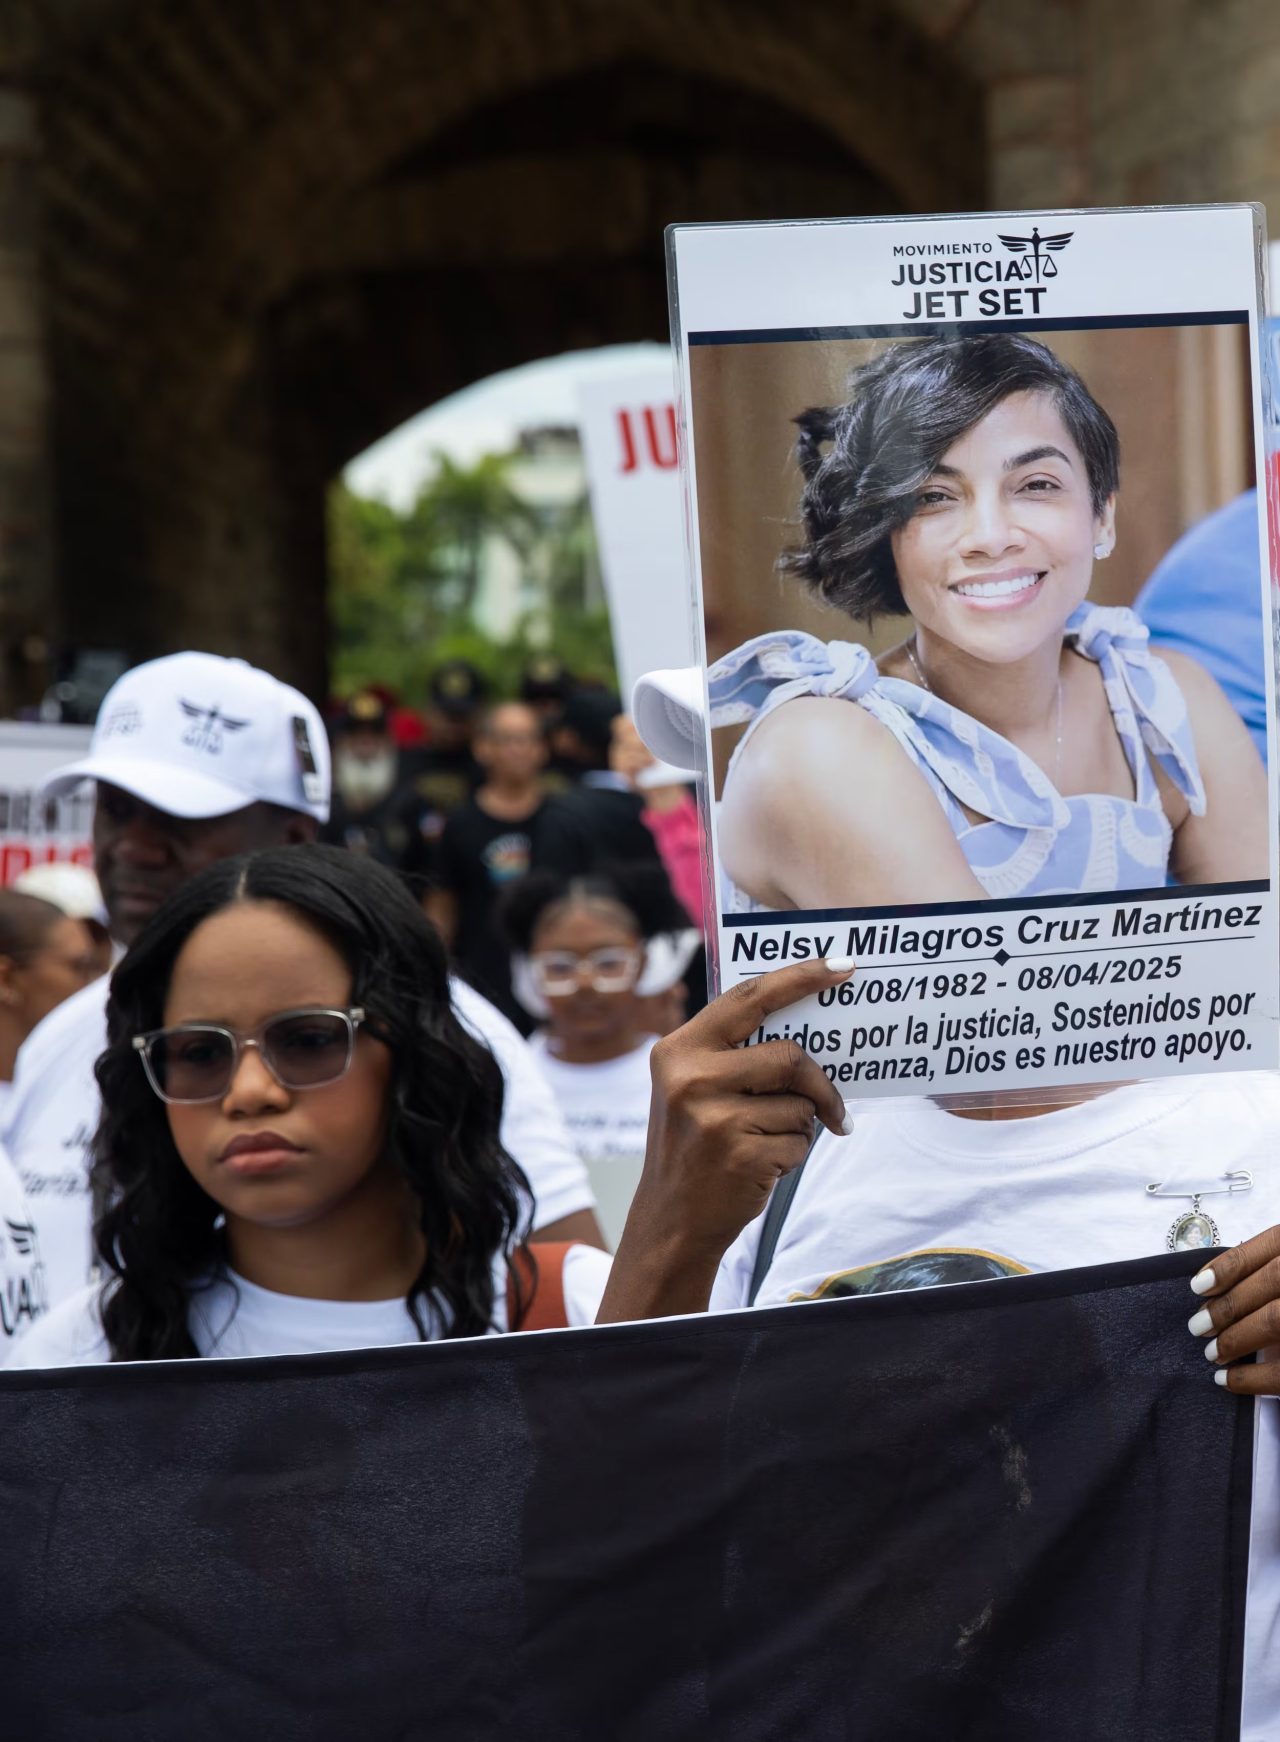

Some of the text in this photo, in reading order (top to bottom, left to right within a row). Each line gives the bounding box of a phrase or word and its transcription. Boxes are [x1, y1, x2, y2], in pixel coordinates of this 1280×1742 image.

[891, 260, 1024, 286] JUSTICIA
[893, 242, 992, 257] MOVIMIENTO
[903, 287, 1047, 319] JET SET
[846, 924, 1004, 958] Milagros
[1018, 915, 1100, 944] Cruz
[1112, 902, 1262, 937] Martínez
[817, 971, 987, 1007] 06/08/1982
[1018, 955, 1182, 991] 08/04/2025
[850, 1021, 898, 1056] por
[905, 1015, 928, 1045] la
[933, 1005, 1041, 1050] justicia,
[1051, 992, 1201, 1032] Sostenidos
[1208, 991, 1256, 1025] por
[945, 1045, 1006, 1075] Dios
[1015, 1045, 1046, 1070] es
[1054, 1032, 1156, 1066] nuestro
[1164, 1027, 1252, 1063] apoyo.
